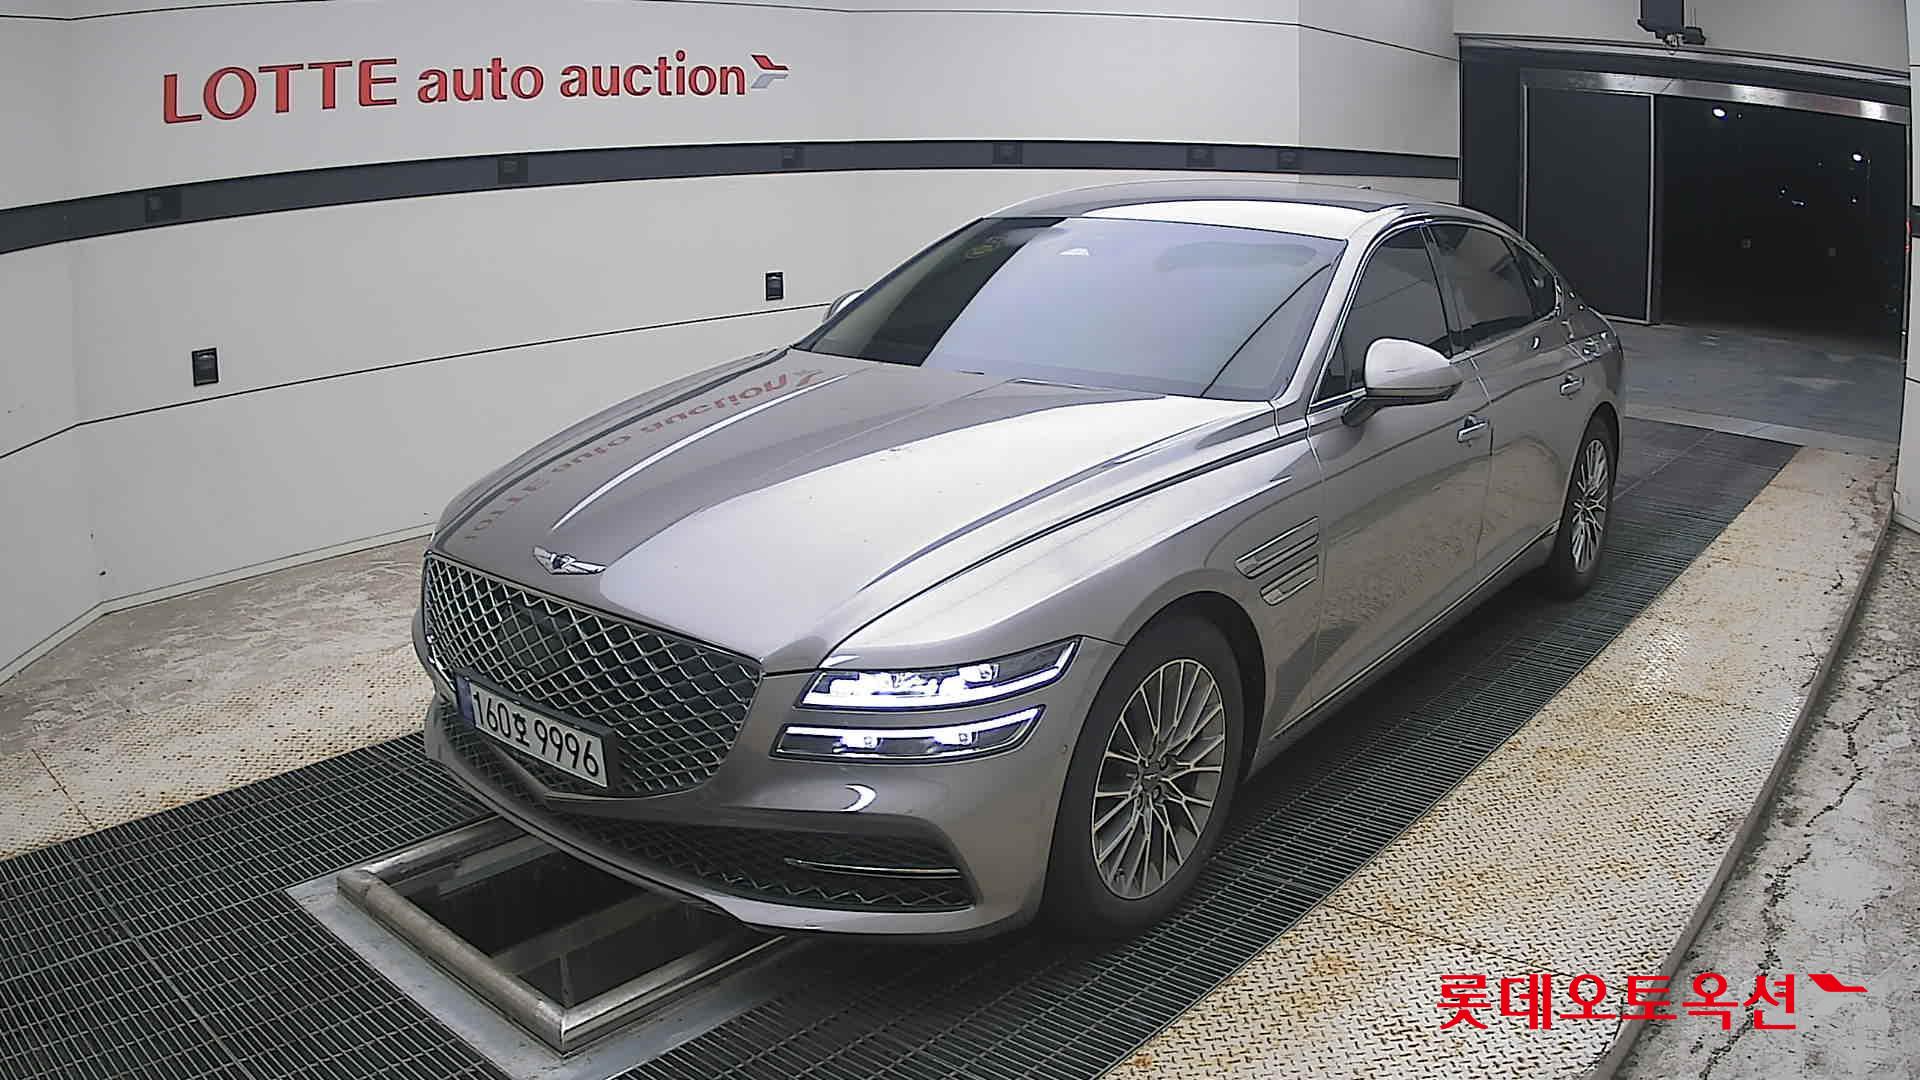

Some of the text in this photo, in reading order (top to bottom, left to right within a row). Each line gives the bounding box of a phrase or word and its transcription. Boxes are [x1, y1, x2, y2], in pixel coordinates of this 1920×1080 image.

[163, 49, 747, 124] LOTTE auto auction
[472, 691, 599, 777] 160호 9996
